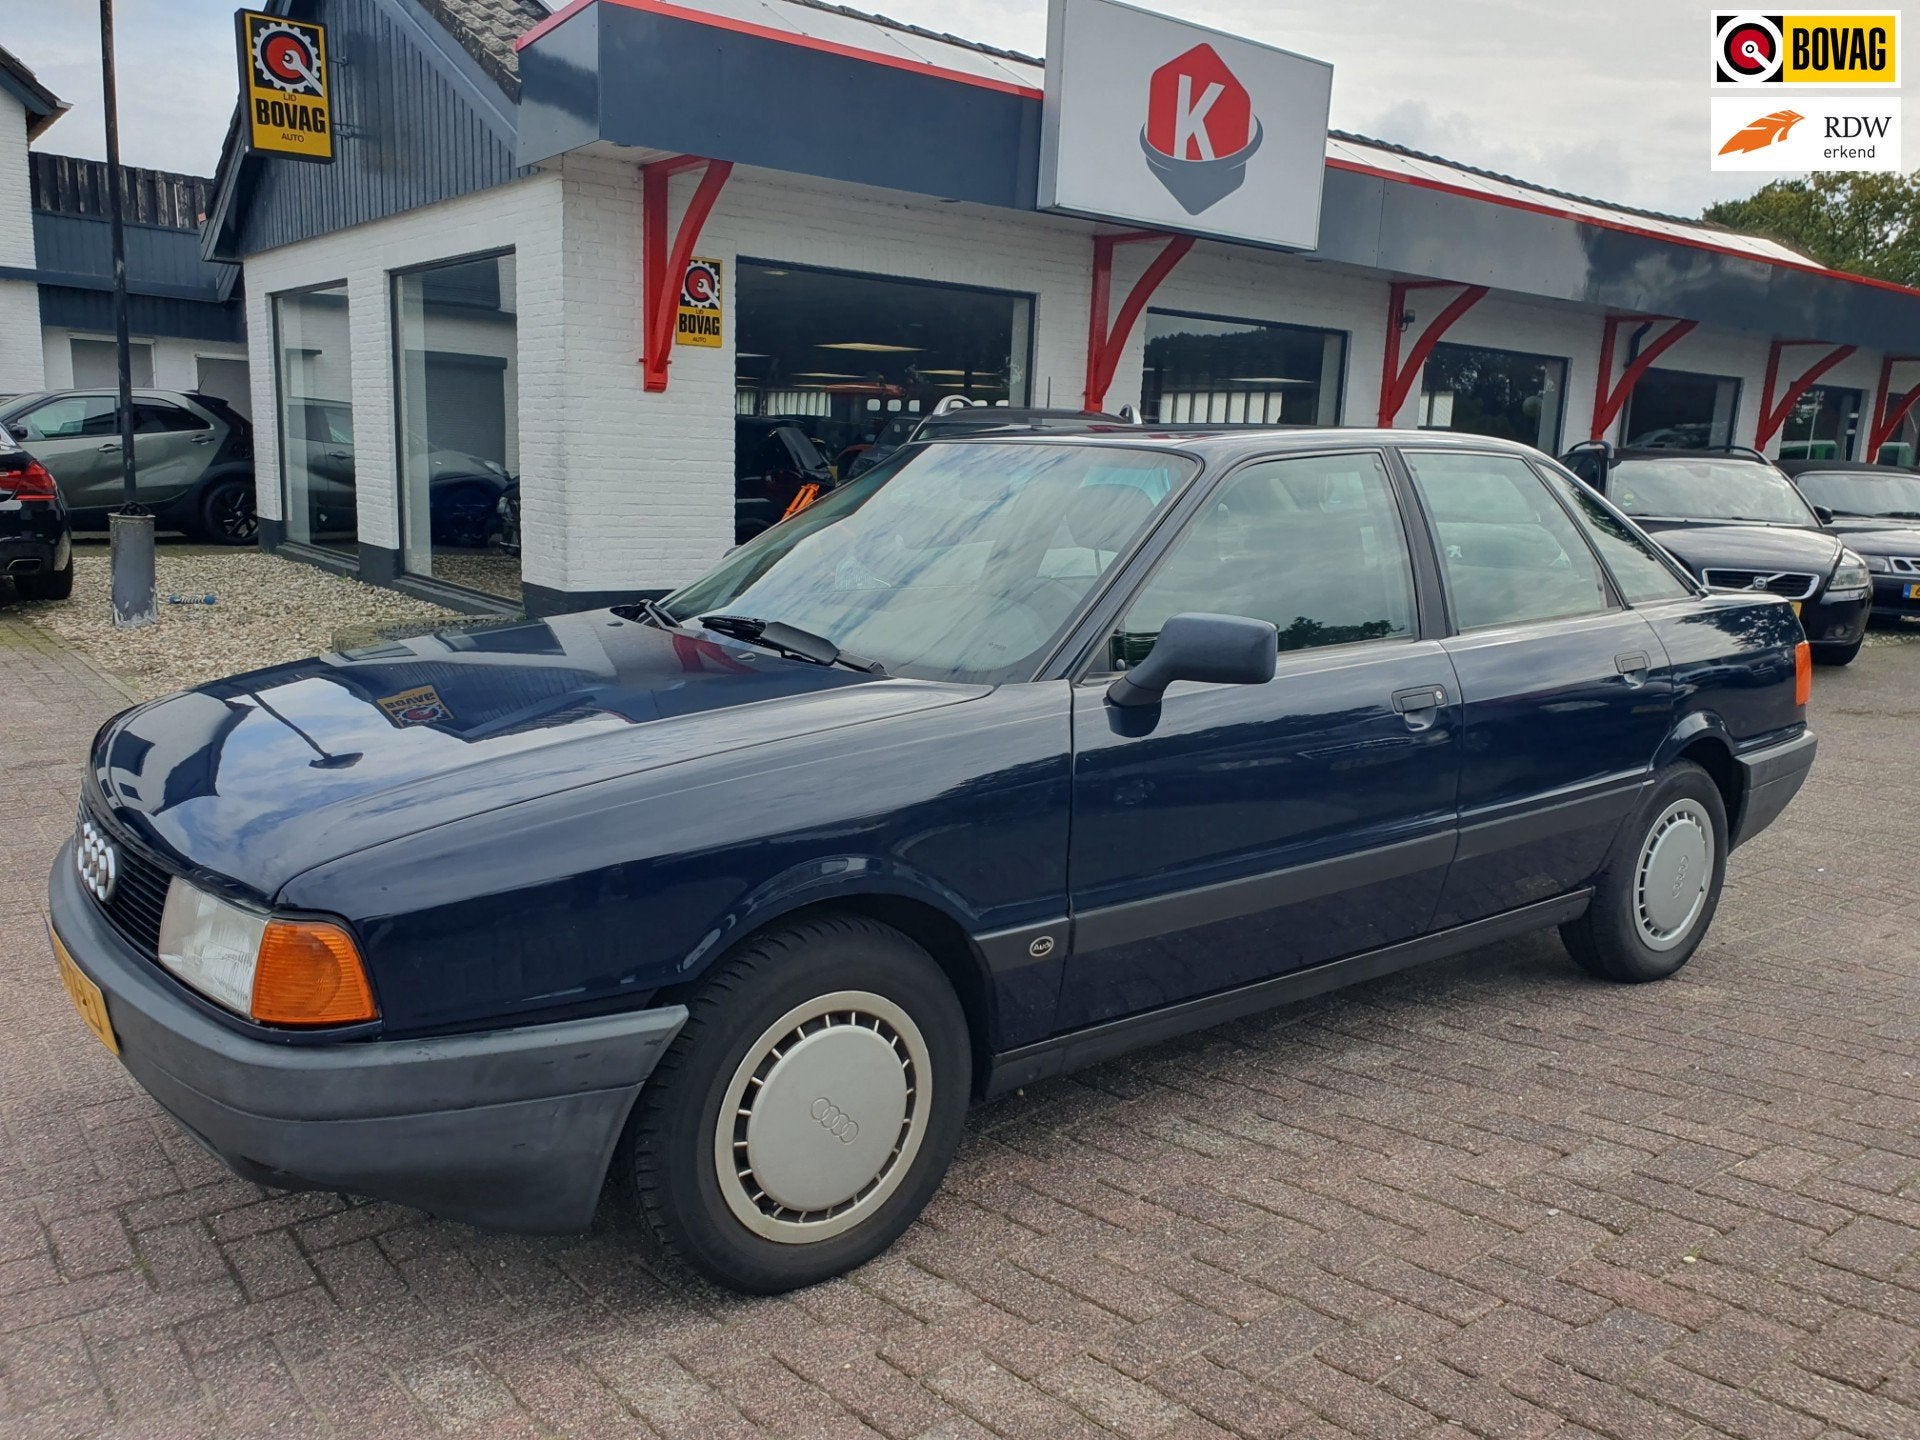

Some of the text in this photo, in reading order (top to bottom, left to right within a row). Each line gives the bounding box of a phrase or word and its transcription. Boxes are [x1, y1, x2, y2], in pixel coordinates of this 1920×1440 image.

[282, 93, 297, 102] LID
[255, 97, 326, 134] BOVAG
[1173, 73, 1226, 161] K
[281, 132, 305, 143] AUTO
[678, 313, 720, 336] BOVAG
